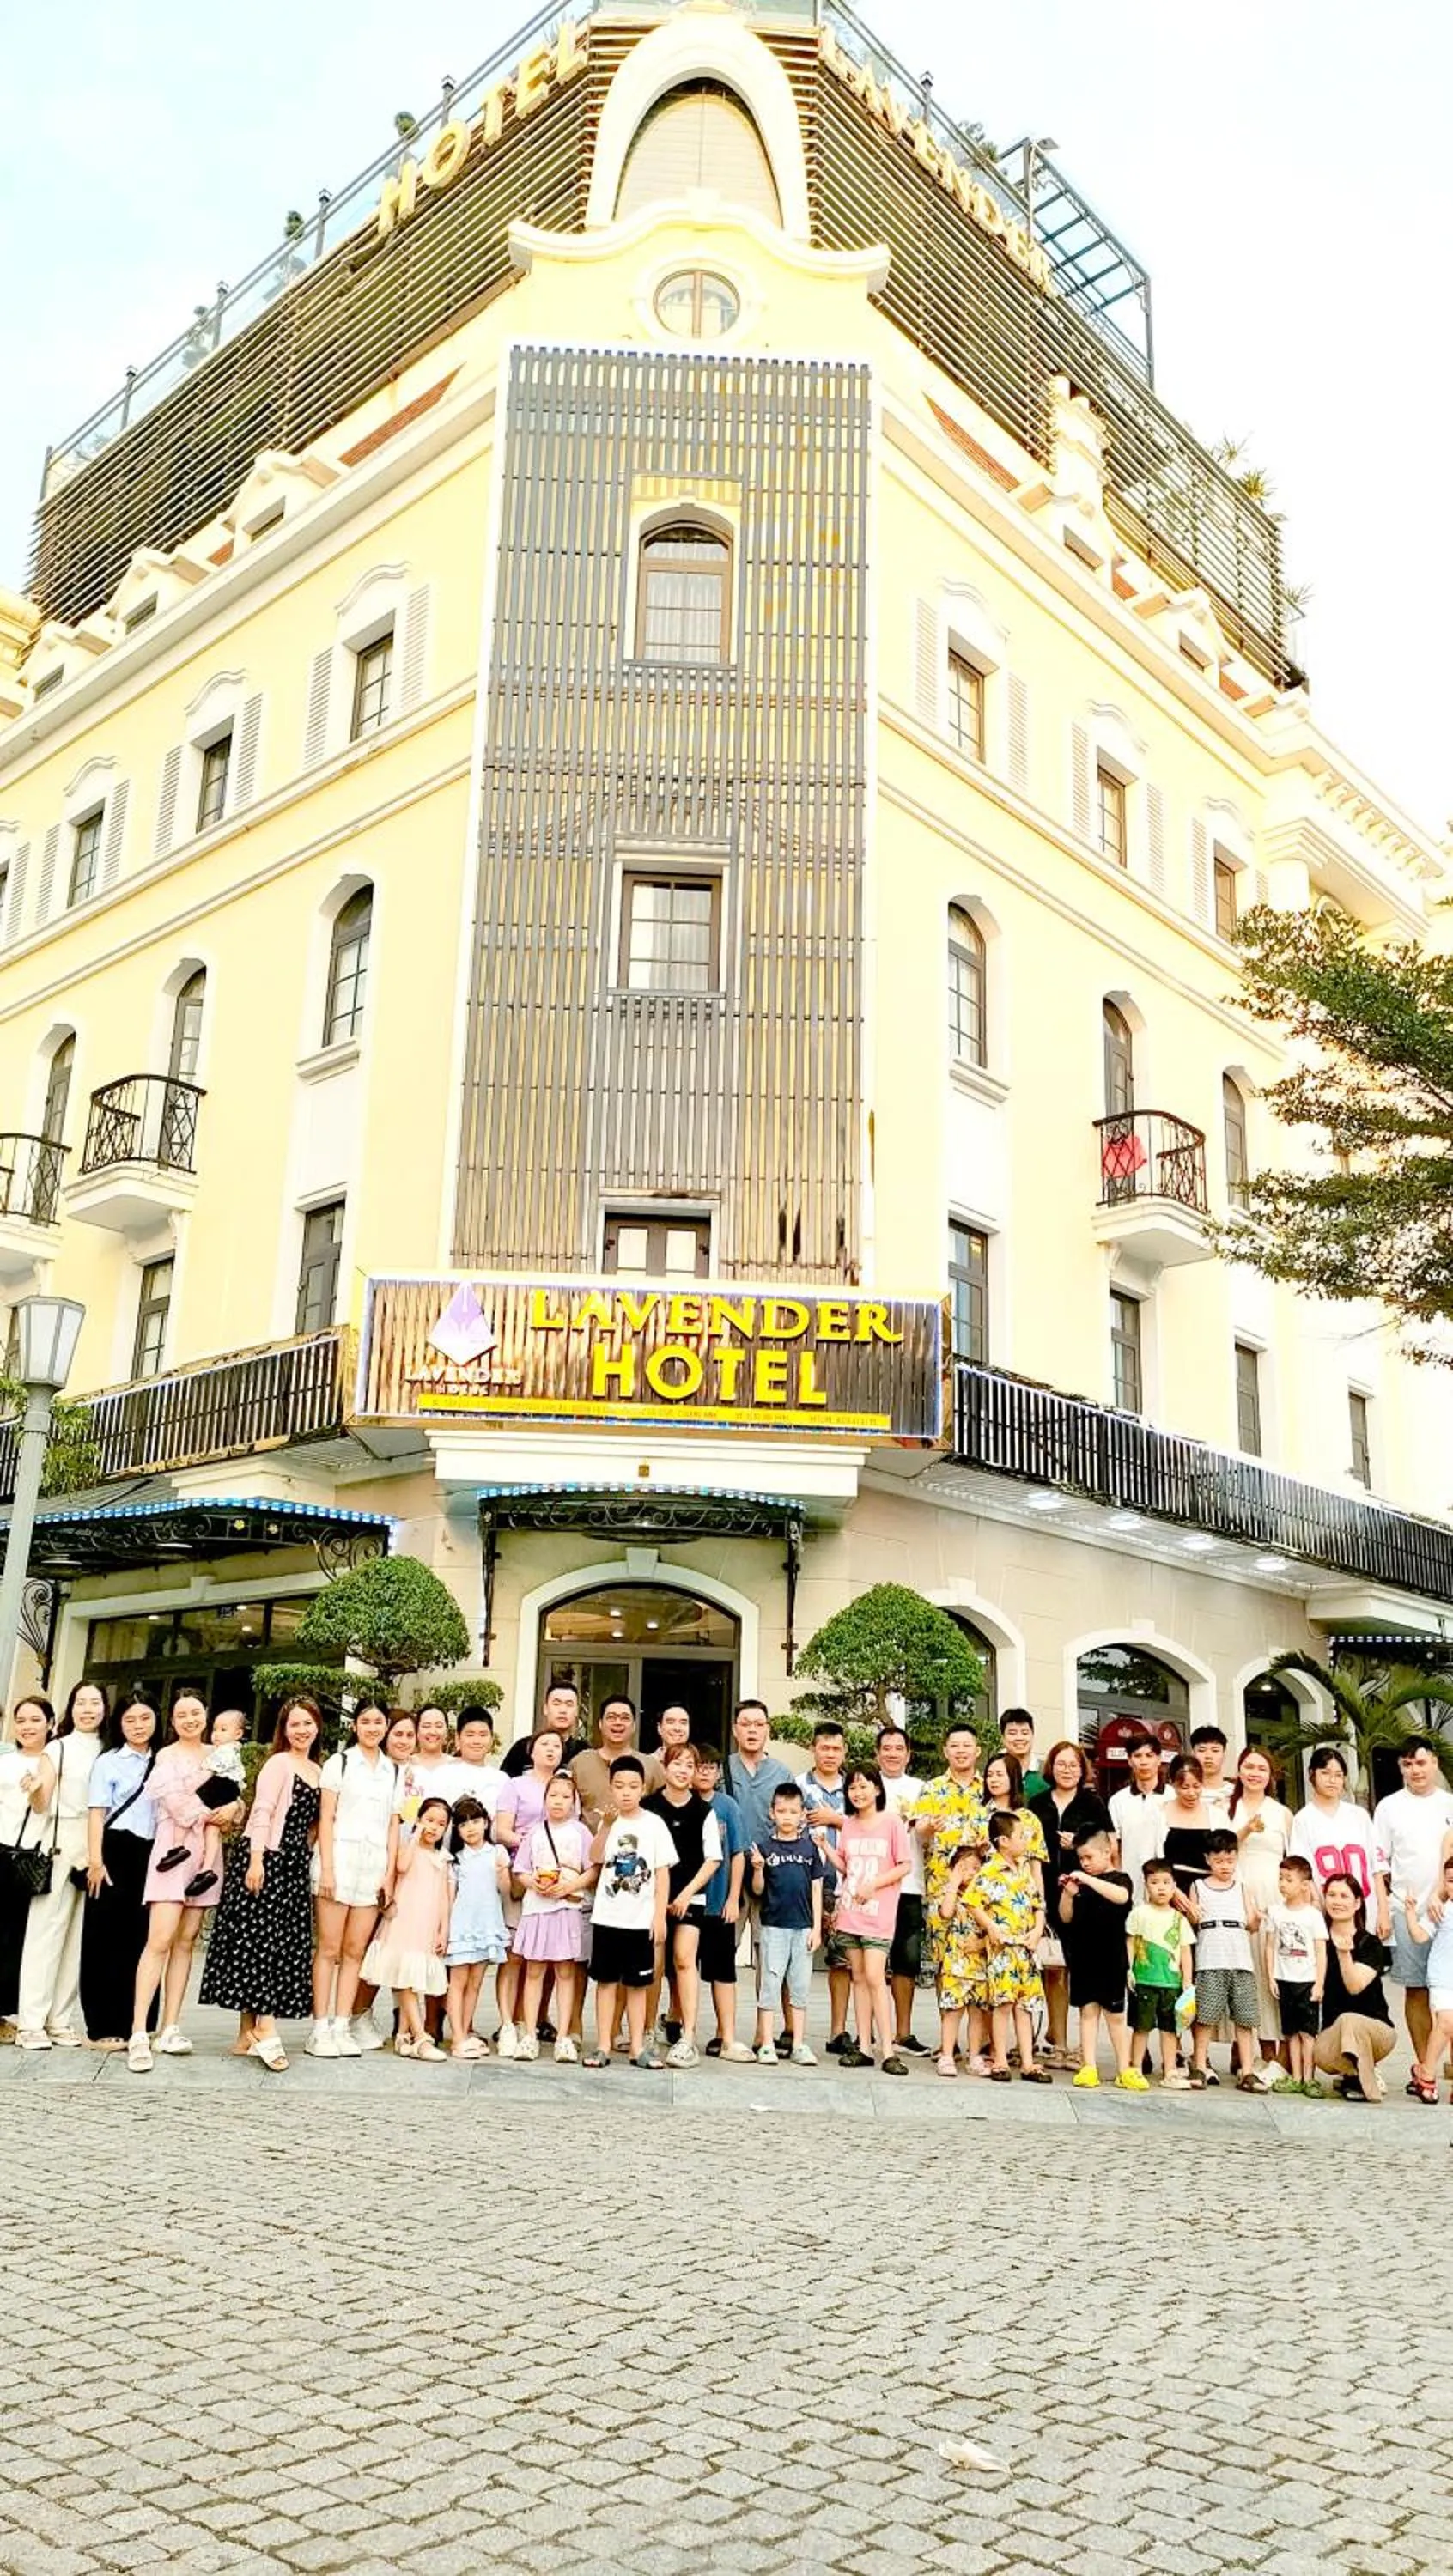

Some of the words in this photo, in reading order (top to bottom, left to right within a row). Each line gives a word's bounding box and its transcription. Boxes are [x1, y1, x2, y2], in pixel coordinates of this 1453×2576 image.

[378, 20, 589, 236] HOTEL
[819, 22, 1055, 299] LAVENDER
[530, 1288, 904, 1344] LAVENDER
[592, 1342, 828, 1406] HOTEL
